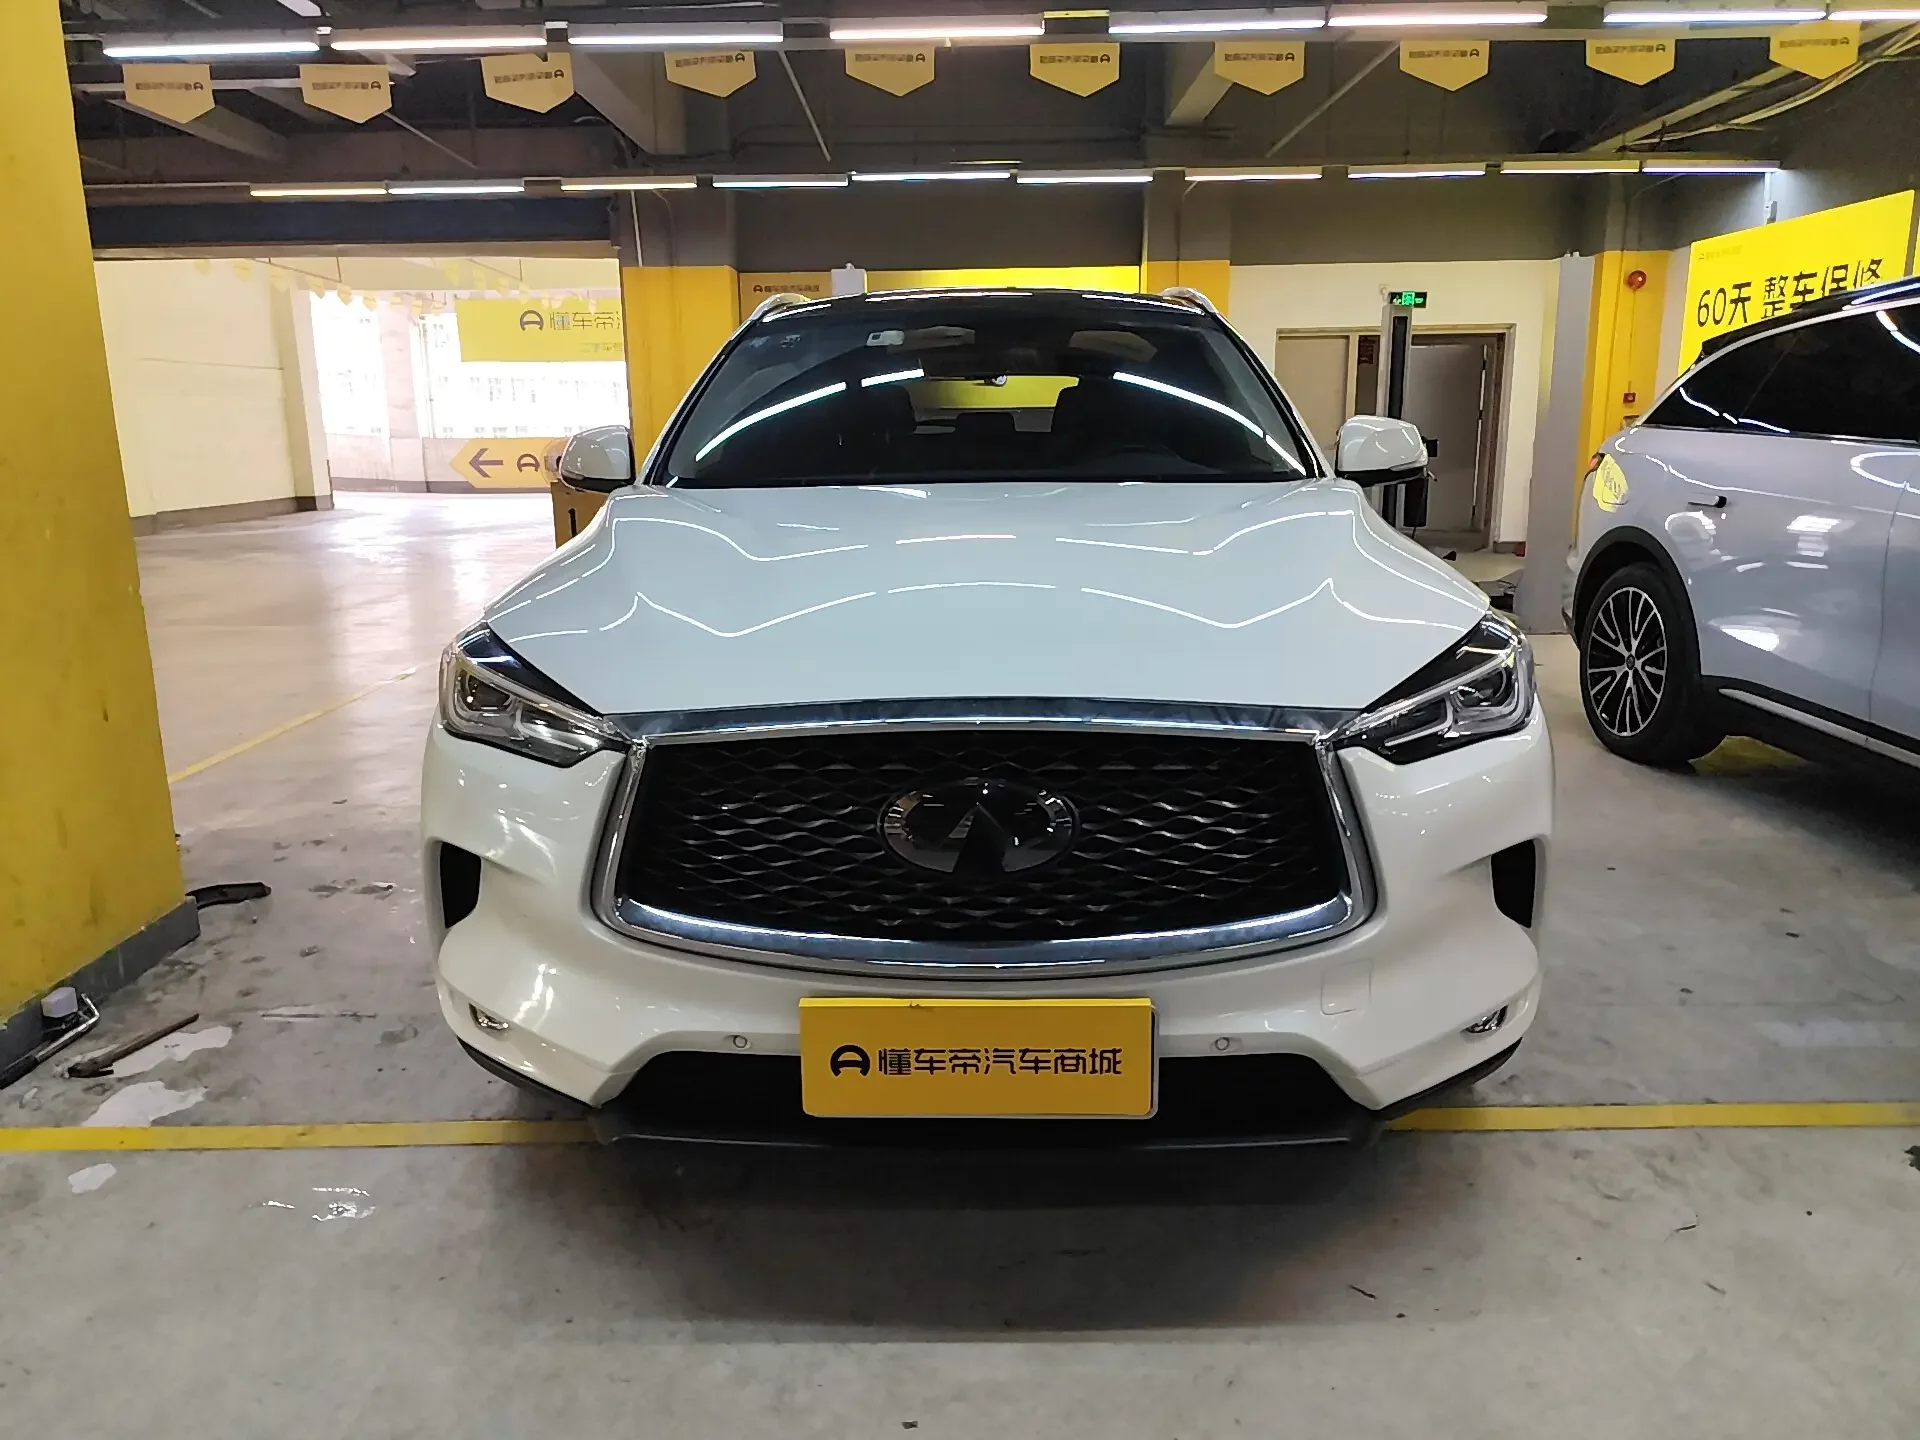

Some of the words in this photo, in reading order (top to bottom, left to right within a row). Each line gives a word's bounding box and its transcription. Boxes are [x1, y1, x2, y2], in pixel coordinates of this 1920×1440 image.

[1697, 282, 1752, 328] 60天
[878, 1047, 1123, 1076] 懂车帝汽车商城
